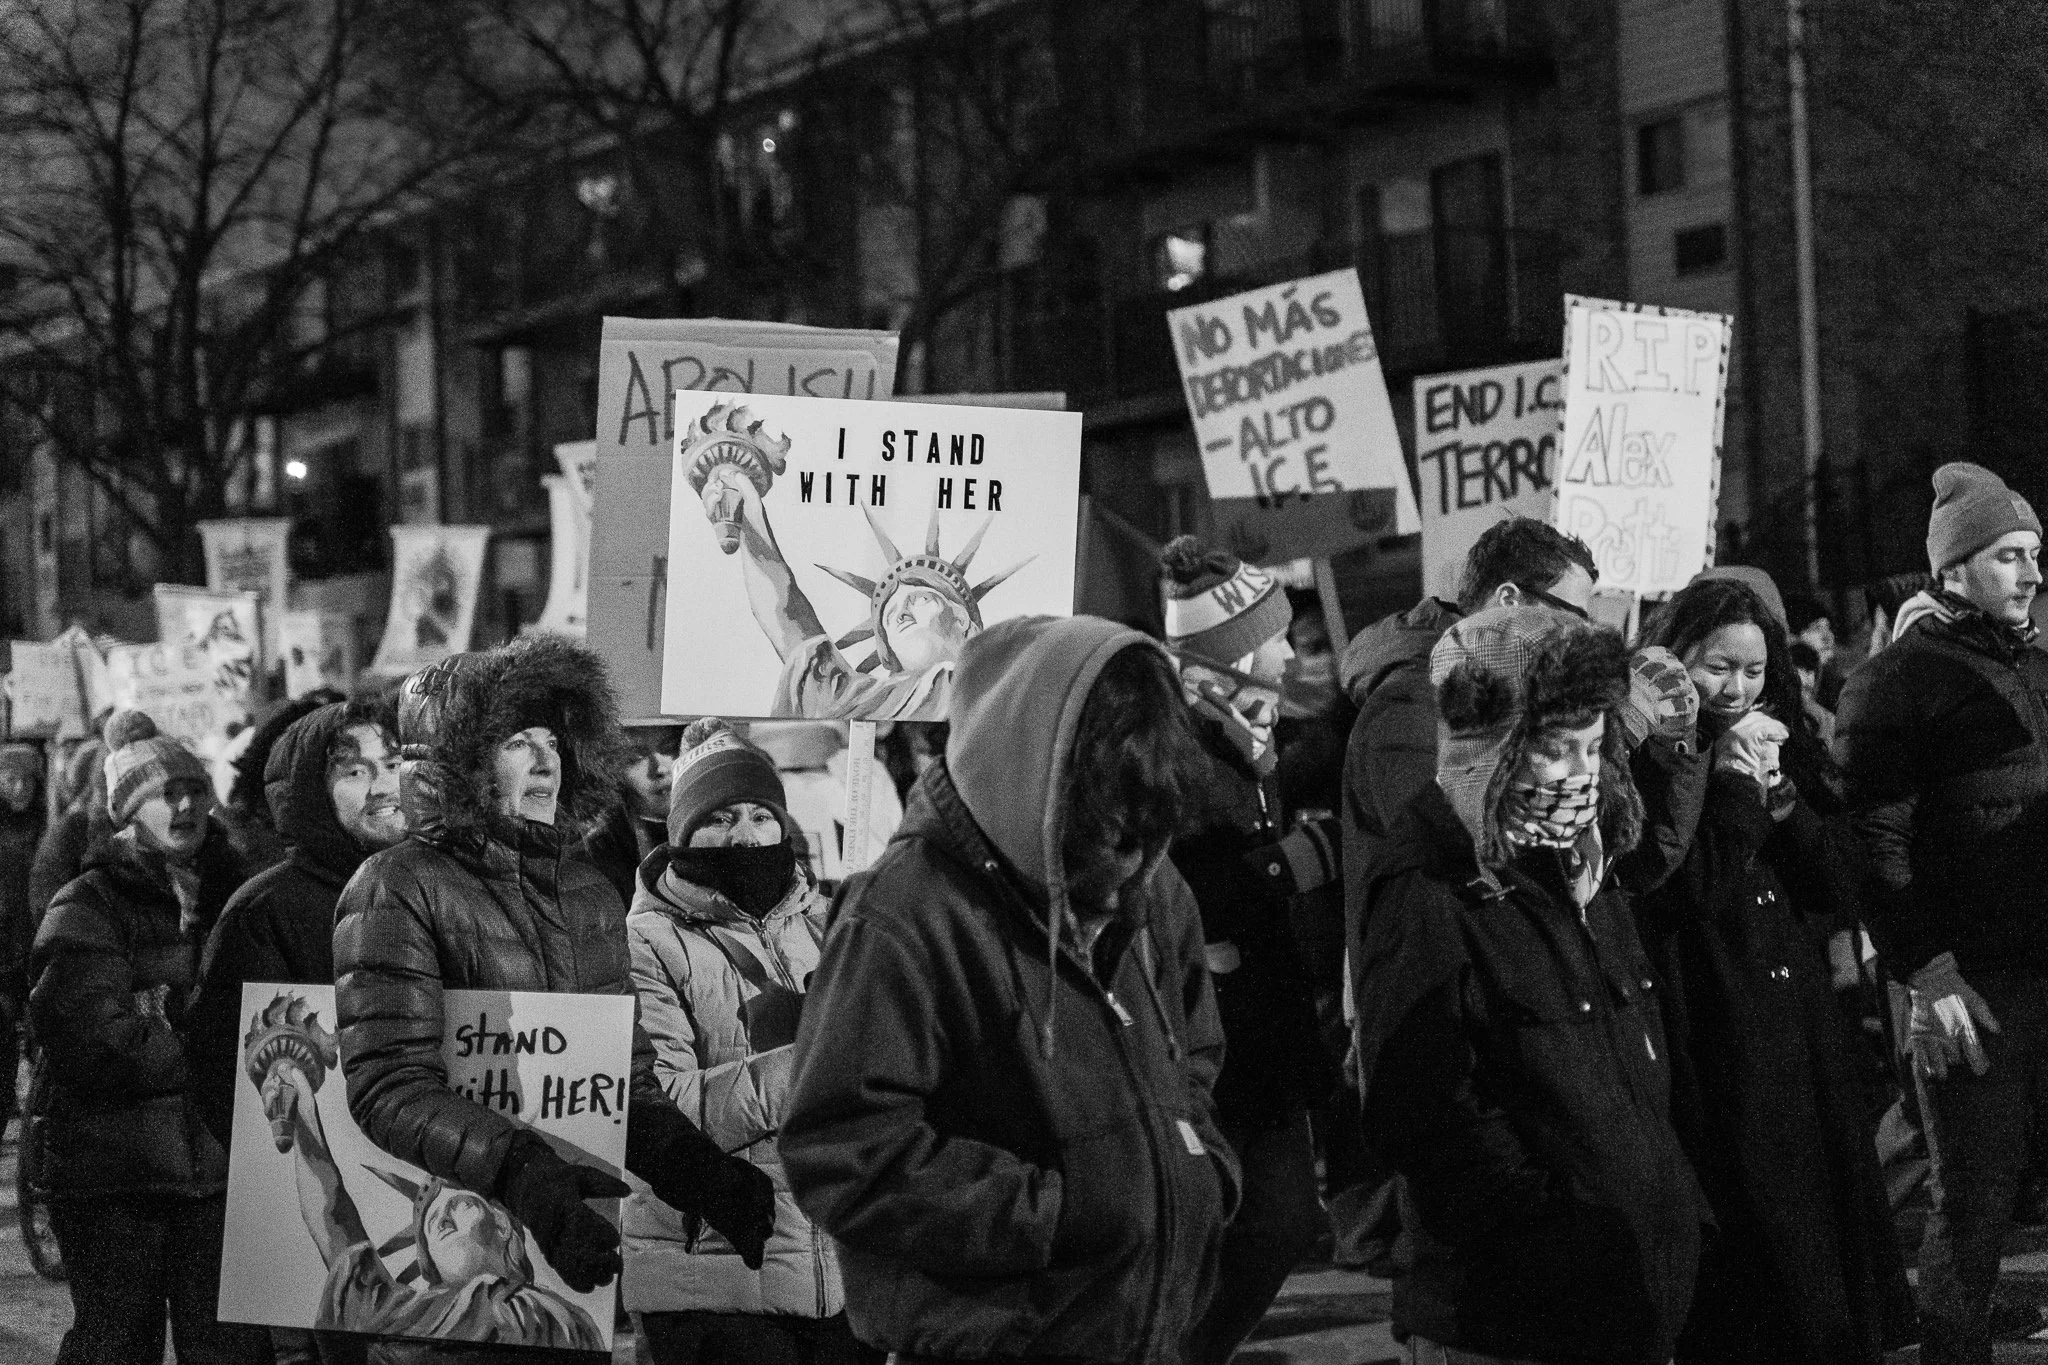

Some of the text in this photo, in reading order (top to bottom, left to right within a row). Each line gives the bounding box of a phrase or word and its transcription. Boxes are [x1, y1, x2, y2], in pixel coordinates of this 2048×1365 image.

[1179, 285, 1342, 367] NO MÁS
[1425, 379, 1504, 434] END
[838, 427, 985, 466] I STAND
[1565, 402, 1678, 489] Alex
[800, 471, 1003, 512] WITH HER
[455, 1068, 626, 1124] ith HER!
